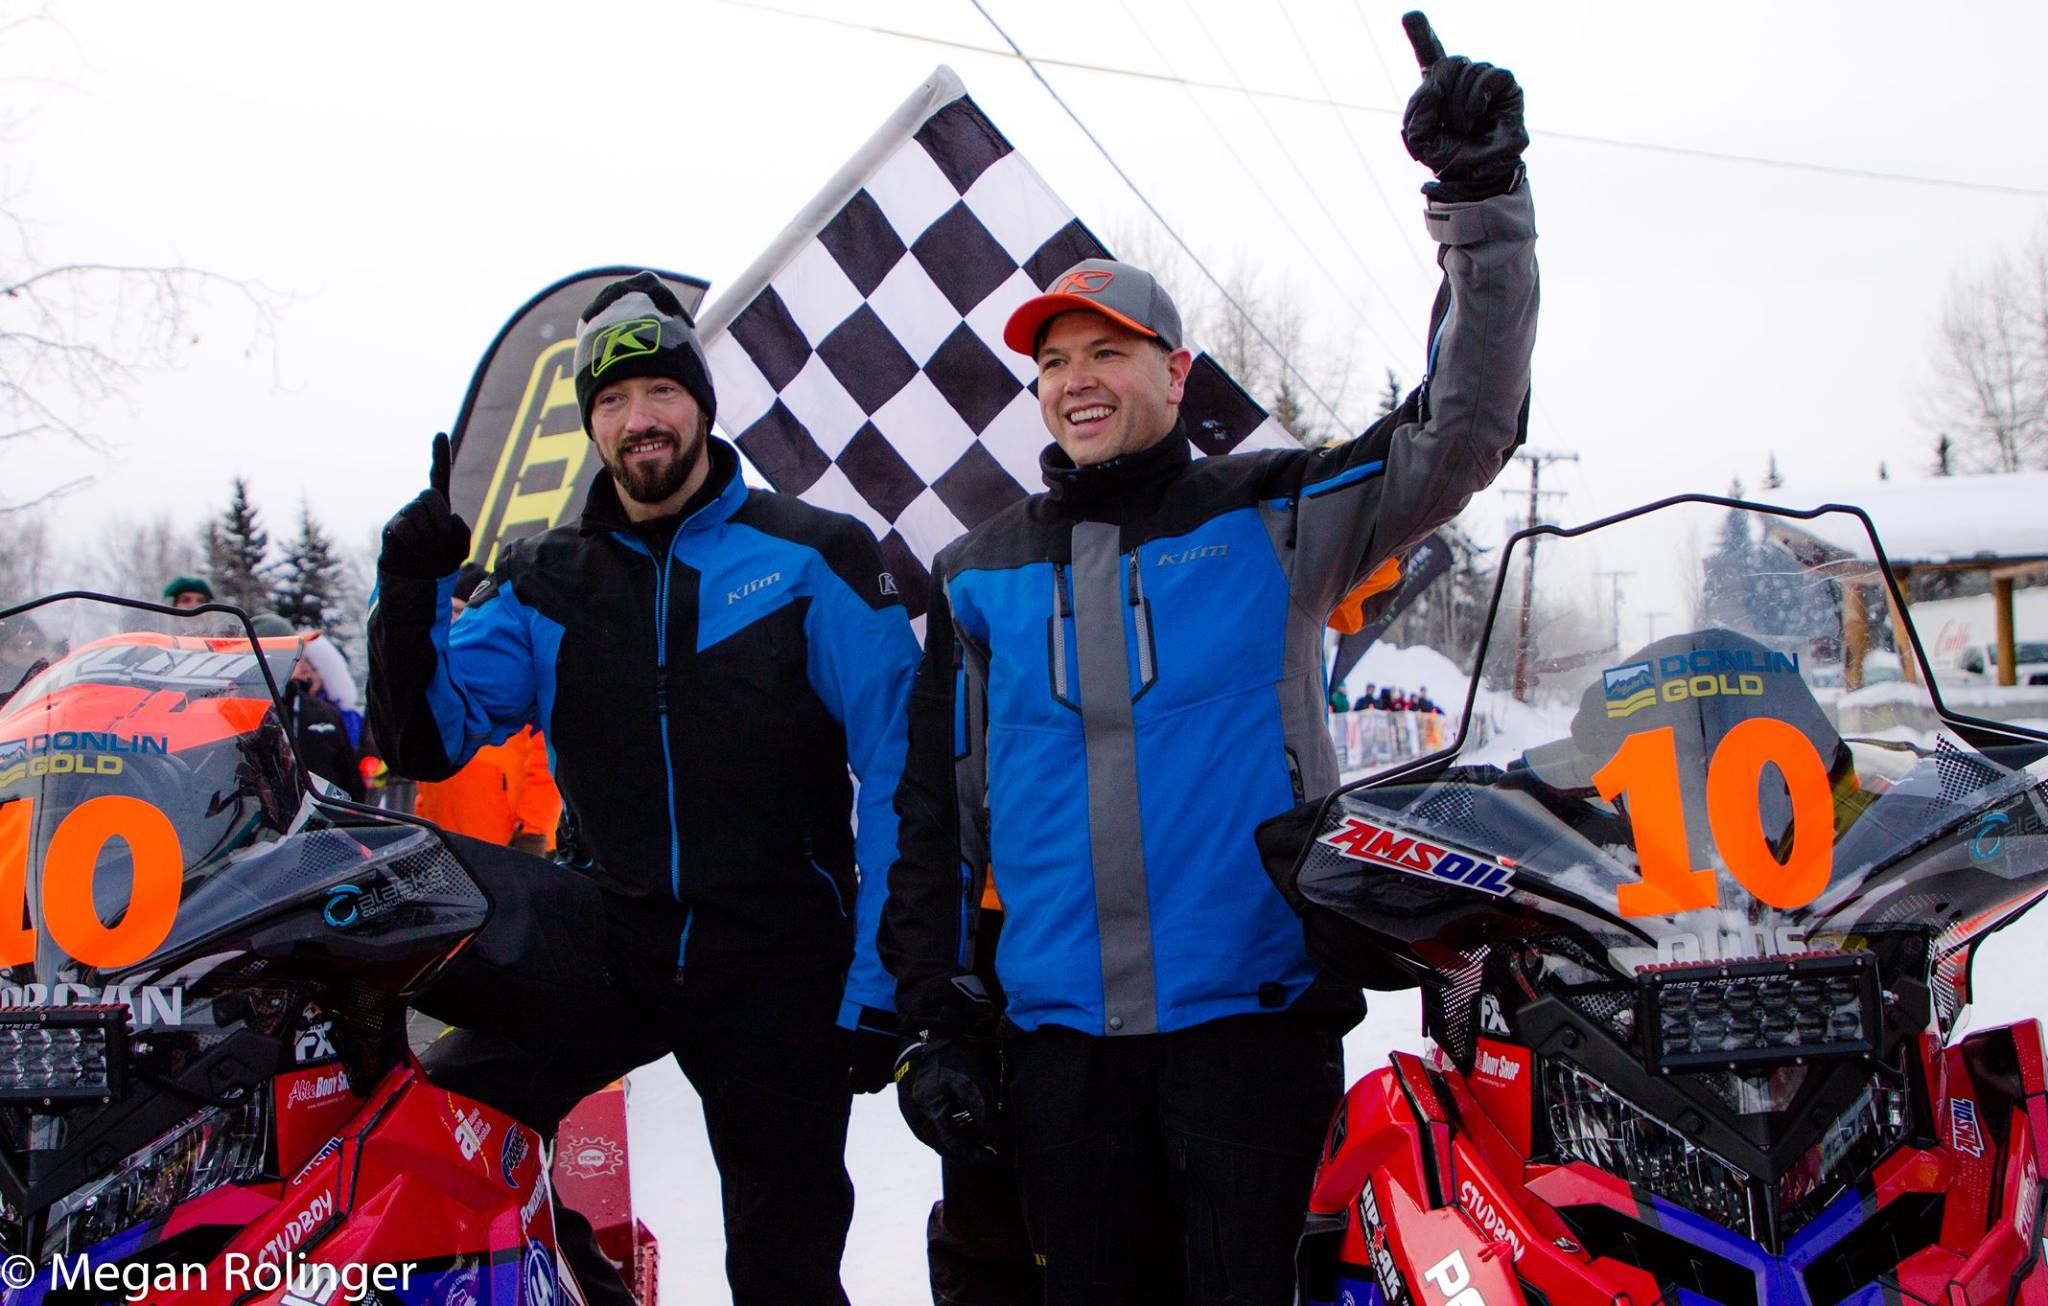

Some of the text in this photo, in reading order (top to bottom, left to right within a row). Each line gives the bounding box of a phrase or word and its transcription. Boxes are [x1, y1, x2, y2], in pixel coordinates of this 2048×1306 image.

[727, 572, 781, 605] Klim
[1659, 648, 1799, 676] DONLIN
[1662, 674, 1764, 703] GOLD
[32, 731, 169, 755] DONLIN
[30, 754, 123, 777] GOLD
[1591, 717, 1834, 917] 10
[1328, 818, 1510, 895] AMSOIL
[1663, 974, 1789, 991] RIGID INDUSTRIES
